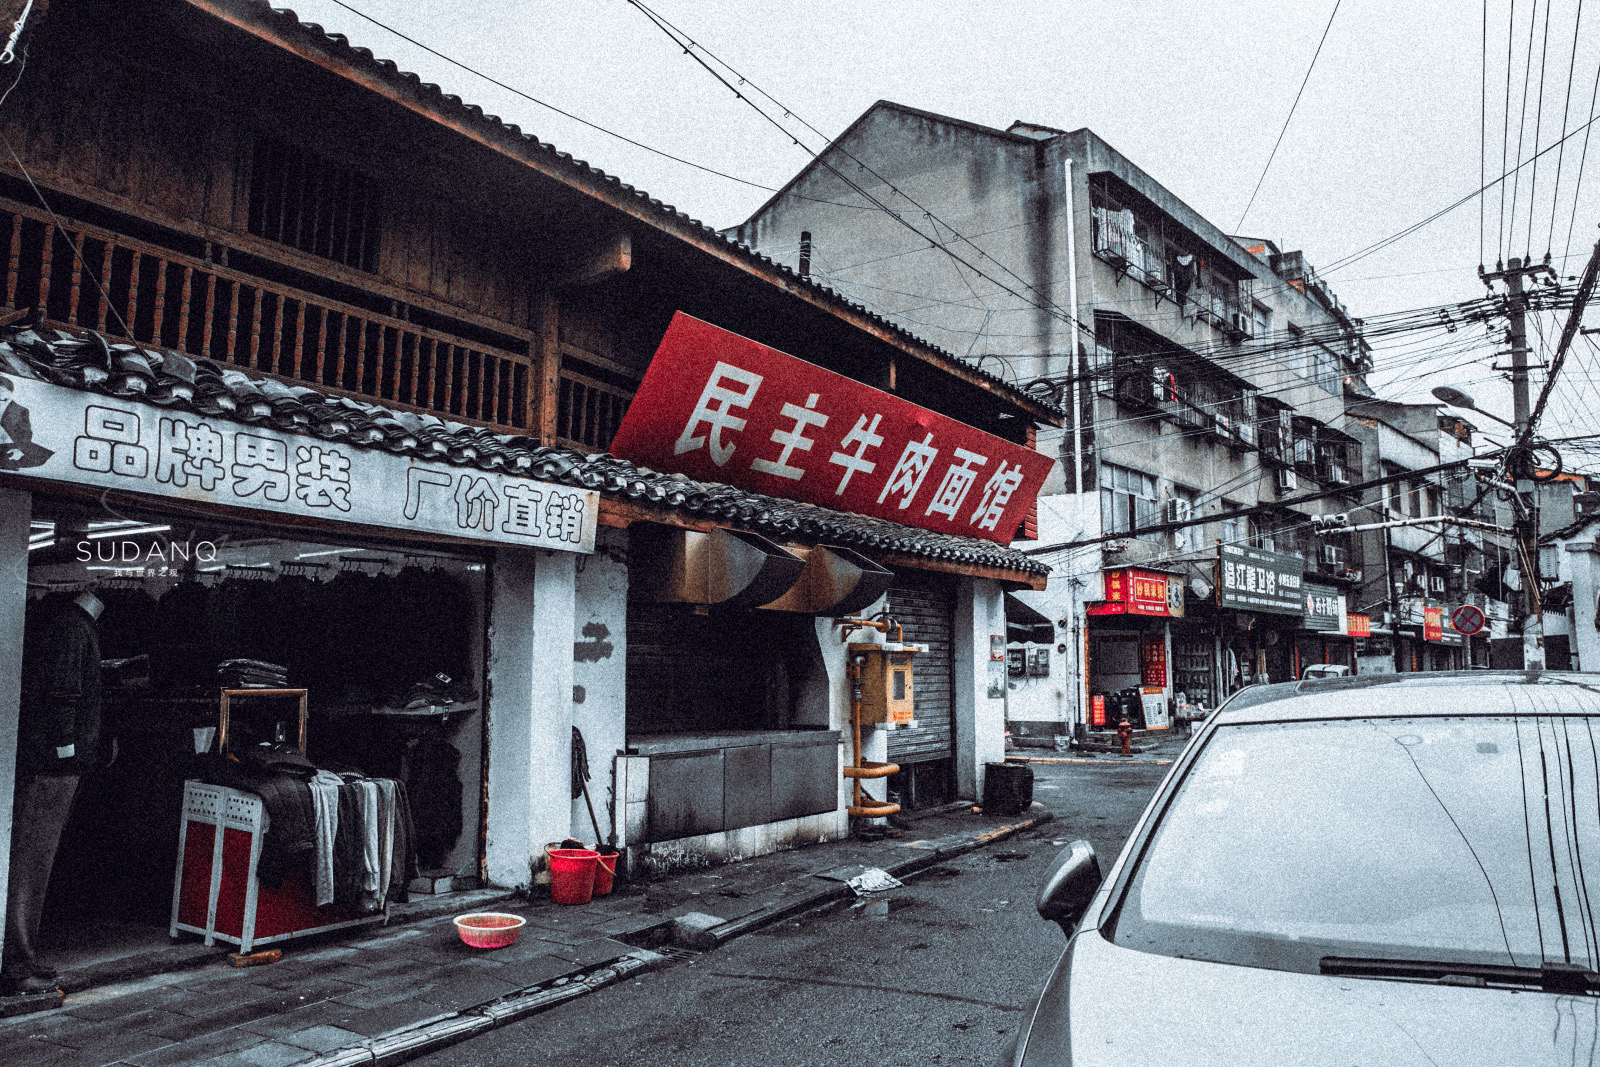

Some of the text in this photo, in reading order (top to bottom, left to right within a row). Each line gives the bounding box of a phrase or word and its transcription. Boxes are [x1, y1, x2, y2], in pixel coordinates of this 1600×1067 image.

[73, 404, 584, 544] 品牌男装 厂价直销
[674, 360, 1024, 532] 民主牛肉面馆
